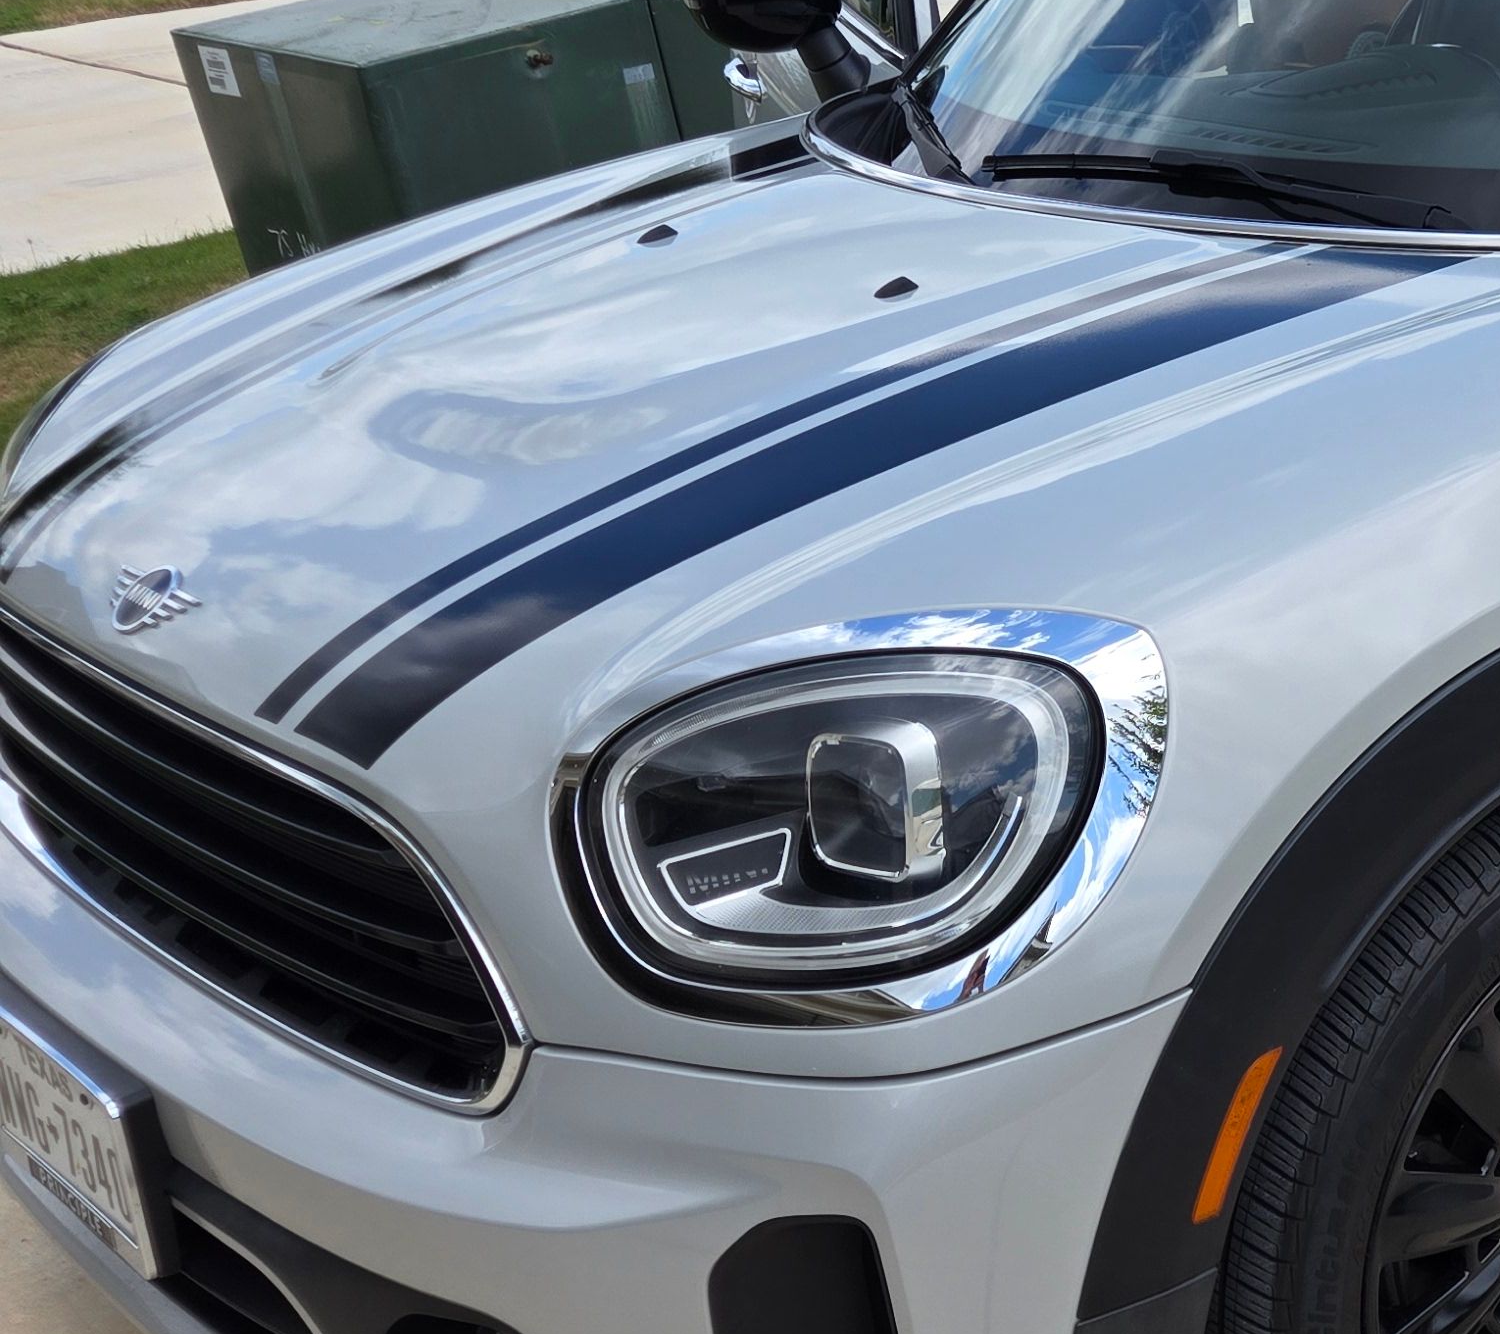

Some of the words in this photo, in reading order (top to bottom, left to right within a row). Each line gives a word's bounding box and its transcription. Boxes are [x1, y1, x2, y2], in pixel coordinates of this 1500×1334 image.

[126, 584, 162, 610] MINI
[12, 1035, 73, 1103] TEXAS
[53, 1104, 131, 1224] 7340
[38, 1167, 104, 1236] PRINCIPLE
